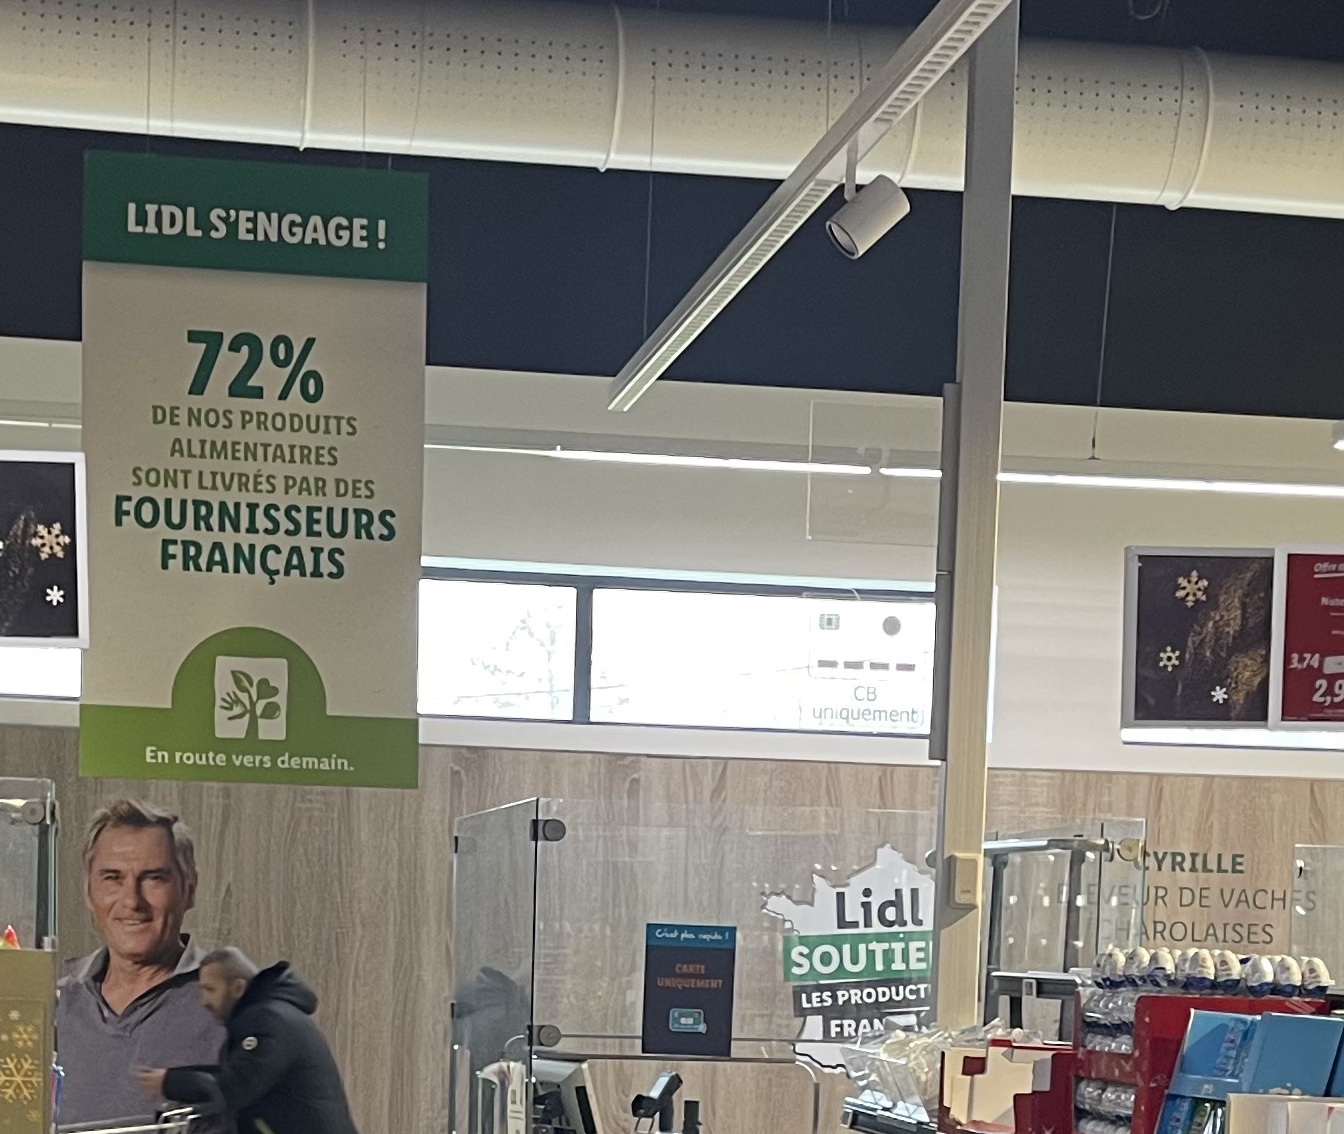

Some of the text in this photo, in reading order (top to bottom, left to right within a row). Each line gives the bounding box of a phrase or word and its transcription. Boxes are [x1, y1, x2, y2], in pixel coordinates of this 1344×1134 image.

[127, 202, 386, 250] LIDL S'ENGAGE !
[186, 329, 324, 404] 72%
[151, 404, 358, 436] DE NOS PRODUITS
[169, 437, 339, 466] ALIMENTAIRES
[132, 467, 376, 500] SONT LIVRÉS PAR DES
[114, 494, 397, 542] FOURNISSEURS
[160, 538, 346, 586] FRANÇAIS
[1289, 653, 1320, 671] 3,74
[853, 685, 877, 702] CB
[812, 706, 919, 725] uniquement
[145, 746, 355, 771] En route vers demain.
[835, 887, 924, 929] Lidl
[1180, 886, 1317, 912] DE VACHES
[675, 963, 705, 975] CARTE
[790, 940, 932, 976] SOUTIE
[656, 976, 723, 990] UNIQUEMENT
[801, 983, 931, 1010] LES PRODUCT
